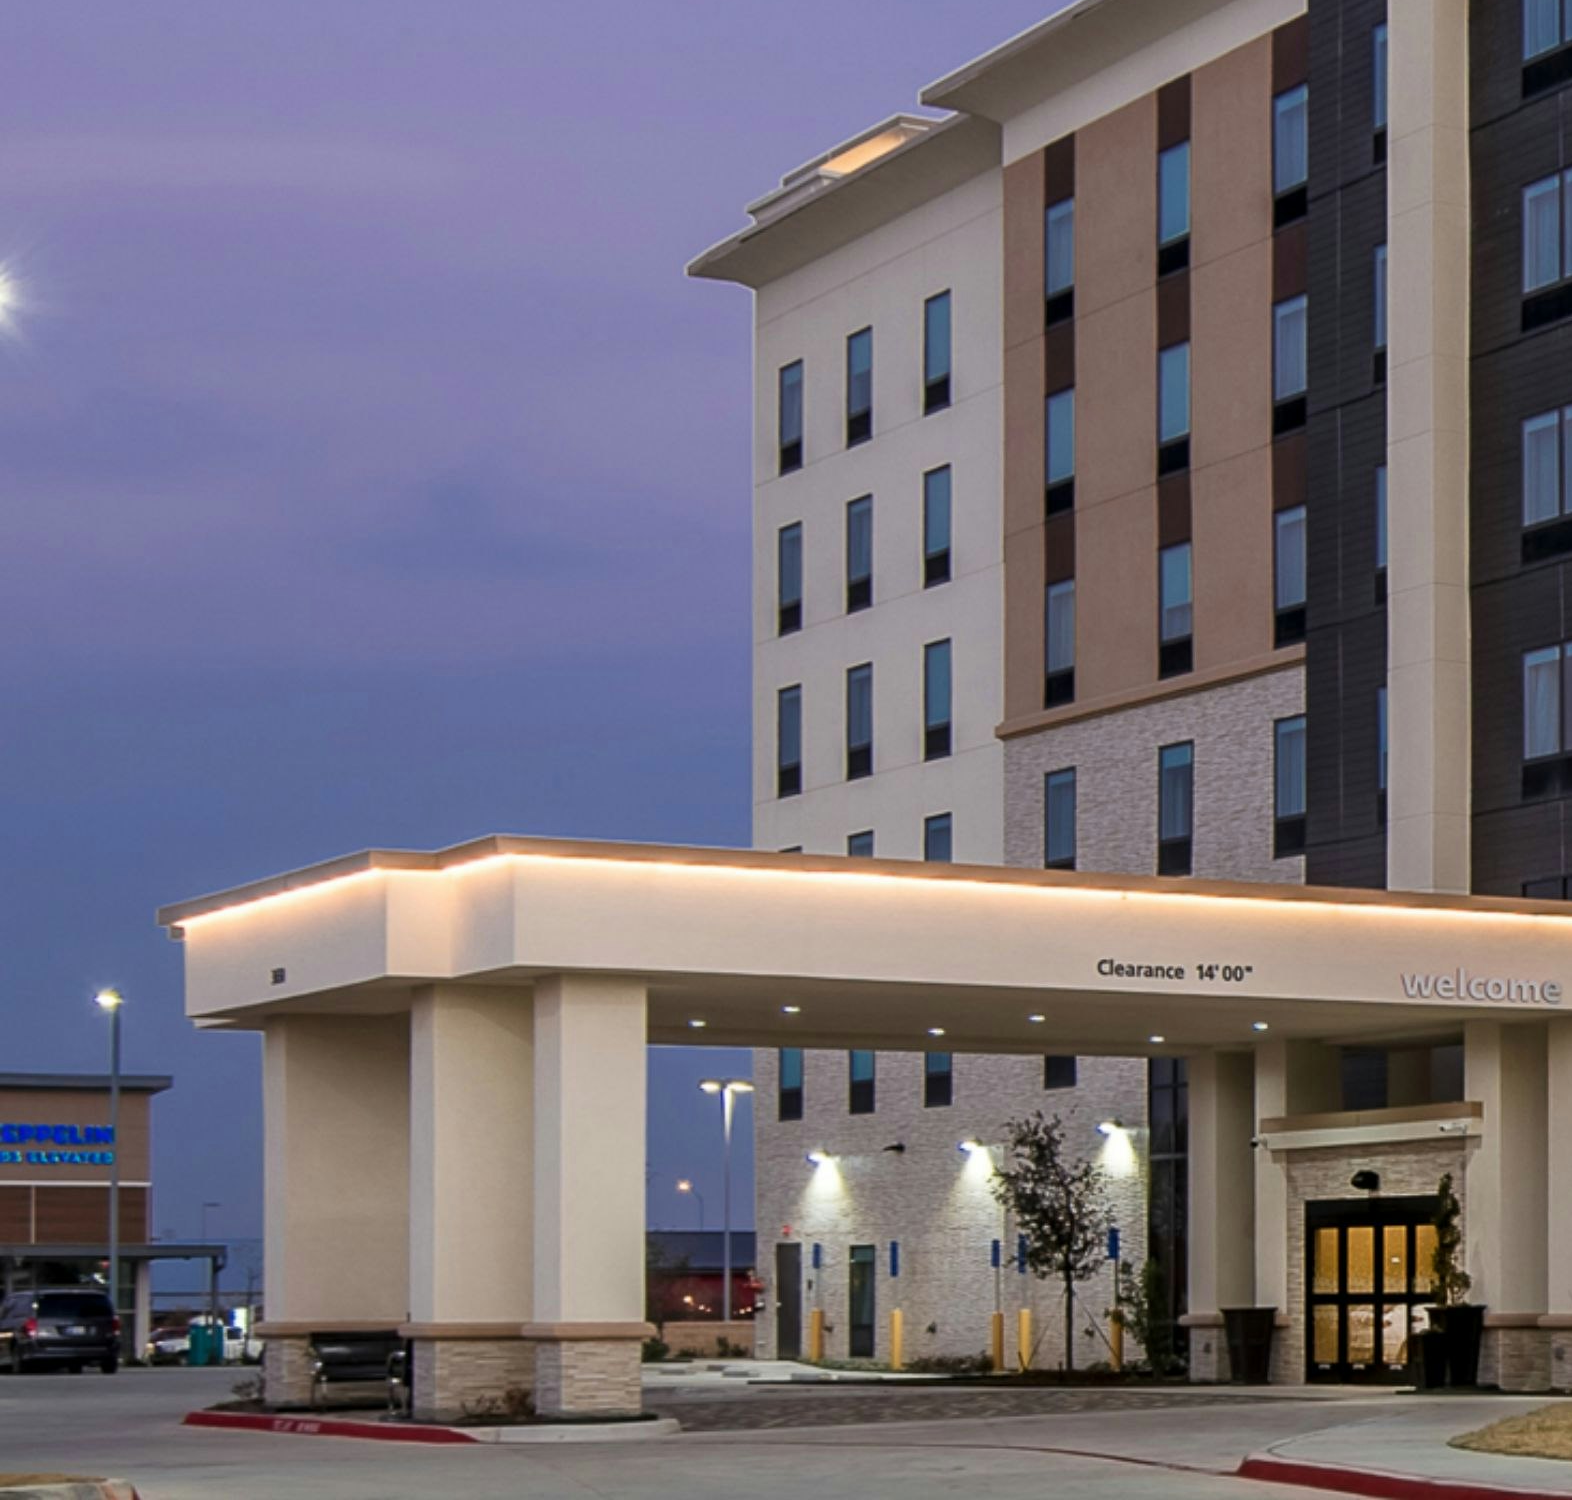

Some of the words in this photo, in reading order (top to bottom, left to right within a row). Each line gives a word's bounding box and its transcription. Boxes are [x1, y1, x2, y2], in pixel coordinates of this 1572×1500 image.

[1097, 958, 1185, 980] Clearance
[1401, 966, 1563, 1004] welcome
[0, 1123, 114, 1144] EPPELIN
